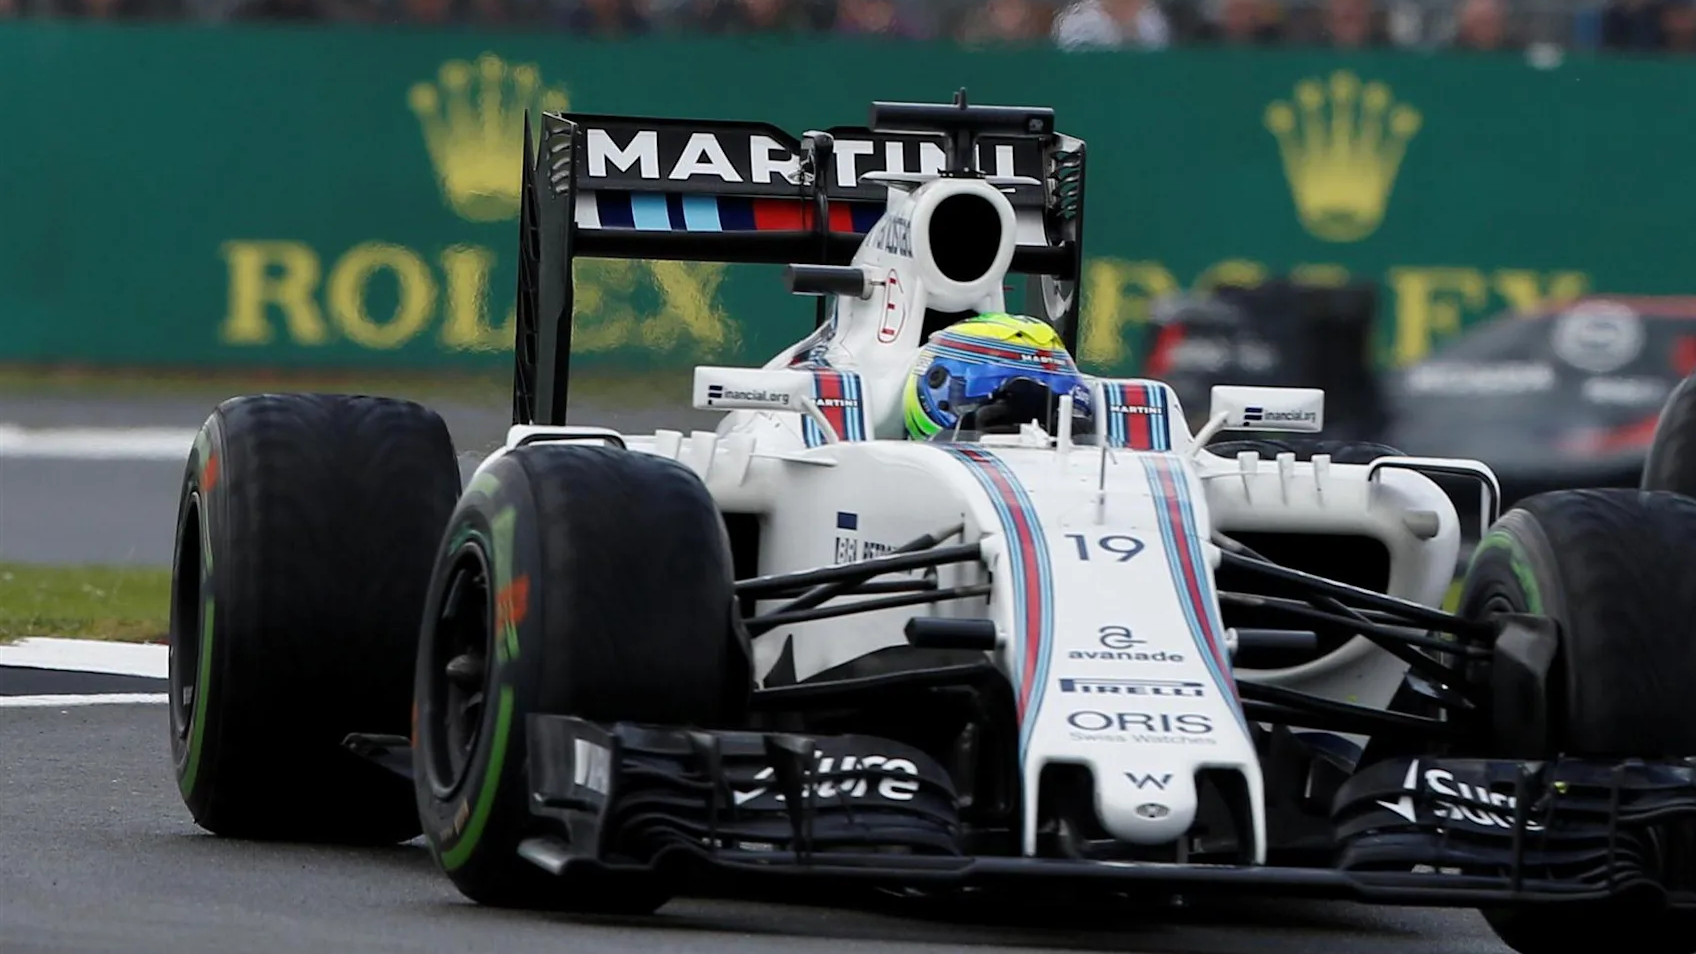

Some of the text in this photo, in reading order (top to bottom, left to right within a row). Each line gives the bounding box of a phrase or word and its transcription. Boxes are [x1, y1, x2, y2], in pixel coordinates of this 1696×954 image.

[1110, 405, 1163, 415] MARTINI
[1064, 533, 1146, 563] 19
[1068, 650, 1185, 662] avanade
[1058, 677, 1205, 697] PIRELLI
[1067, 710, 1214, 735] ORIS
[1124, 772, 1173, 791] W
